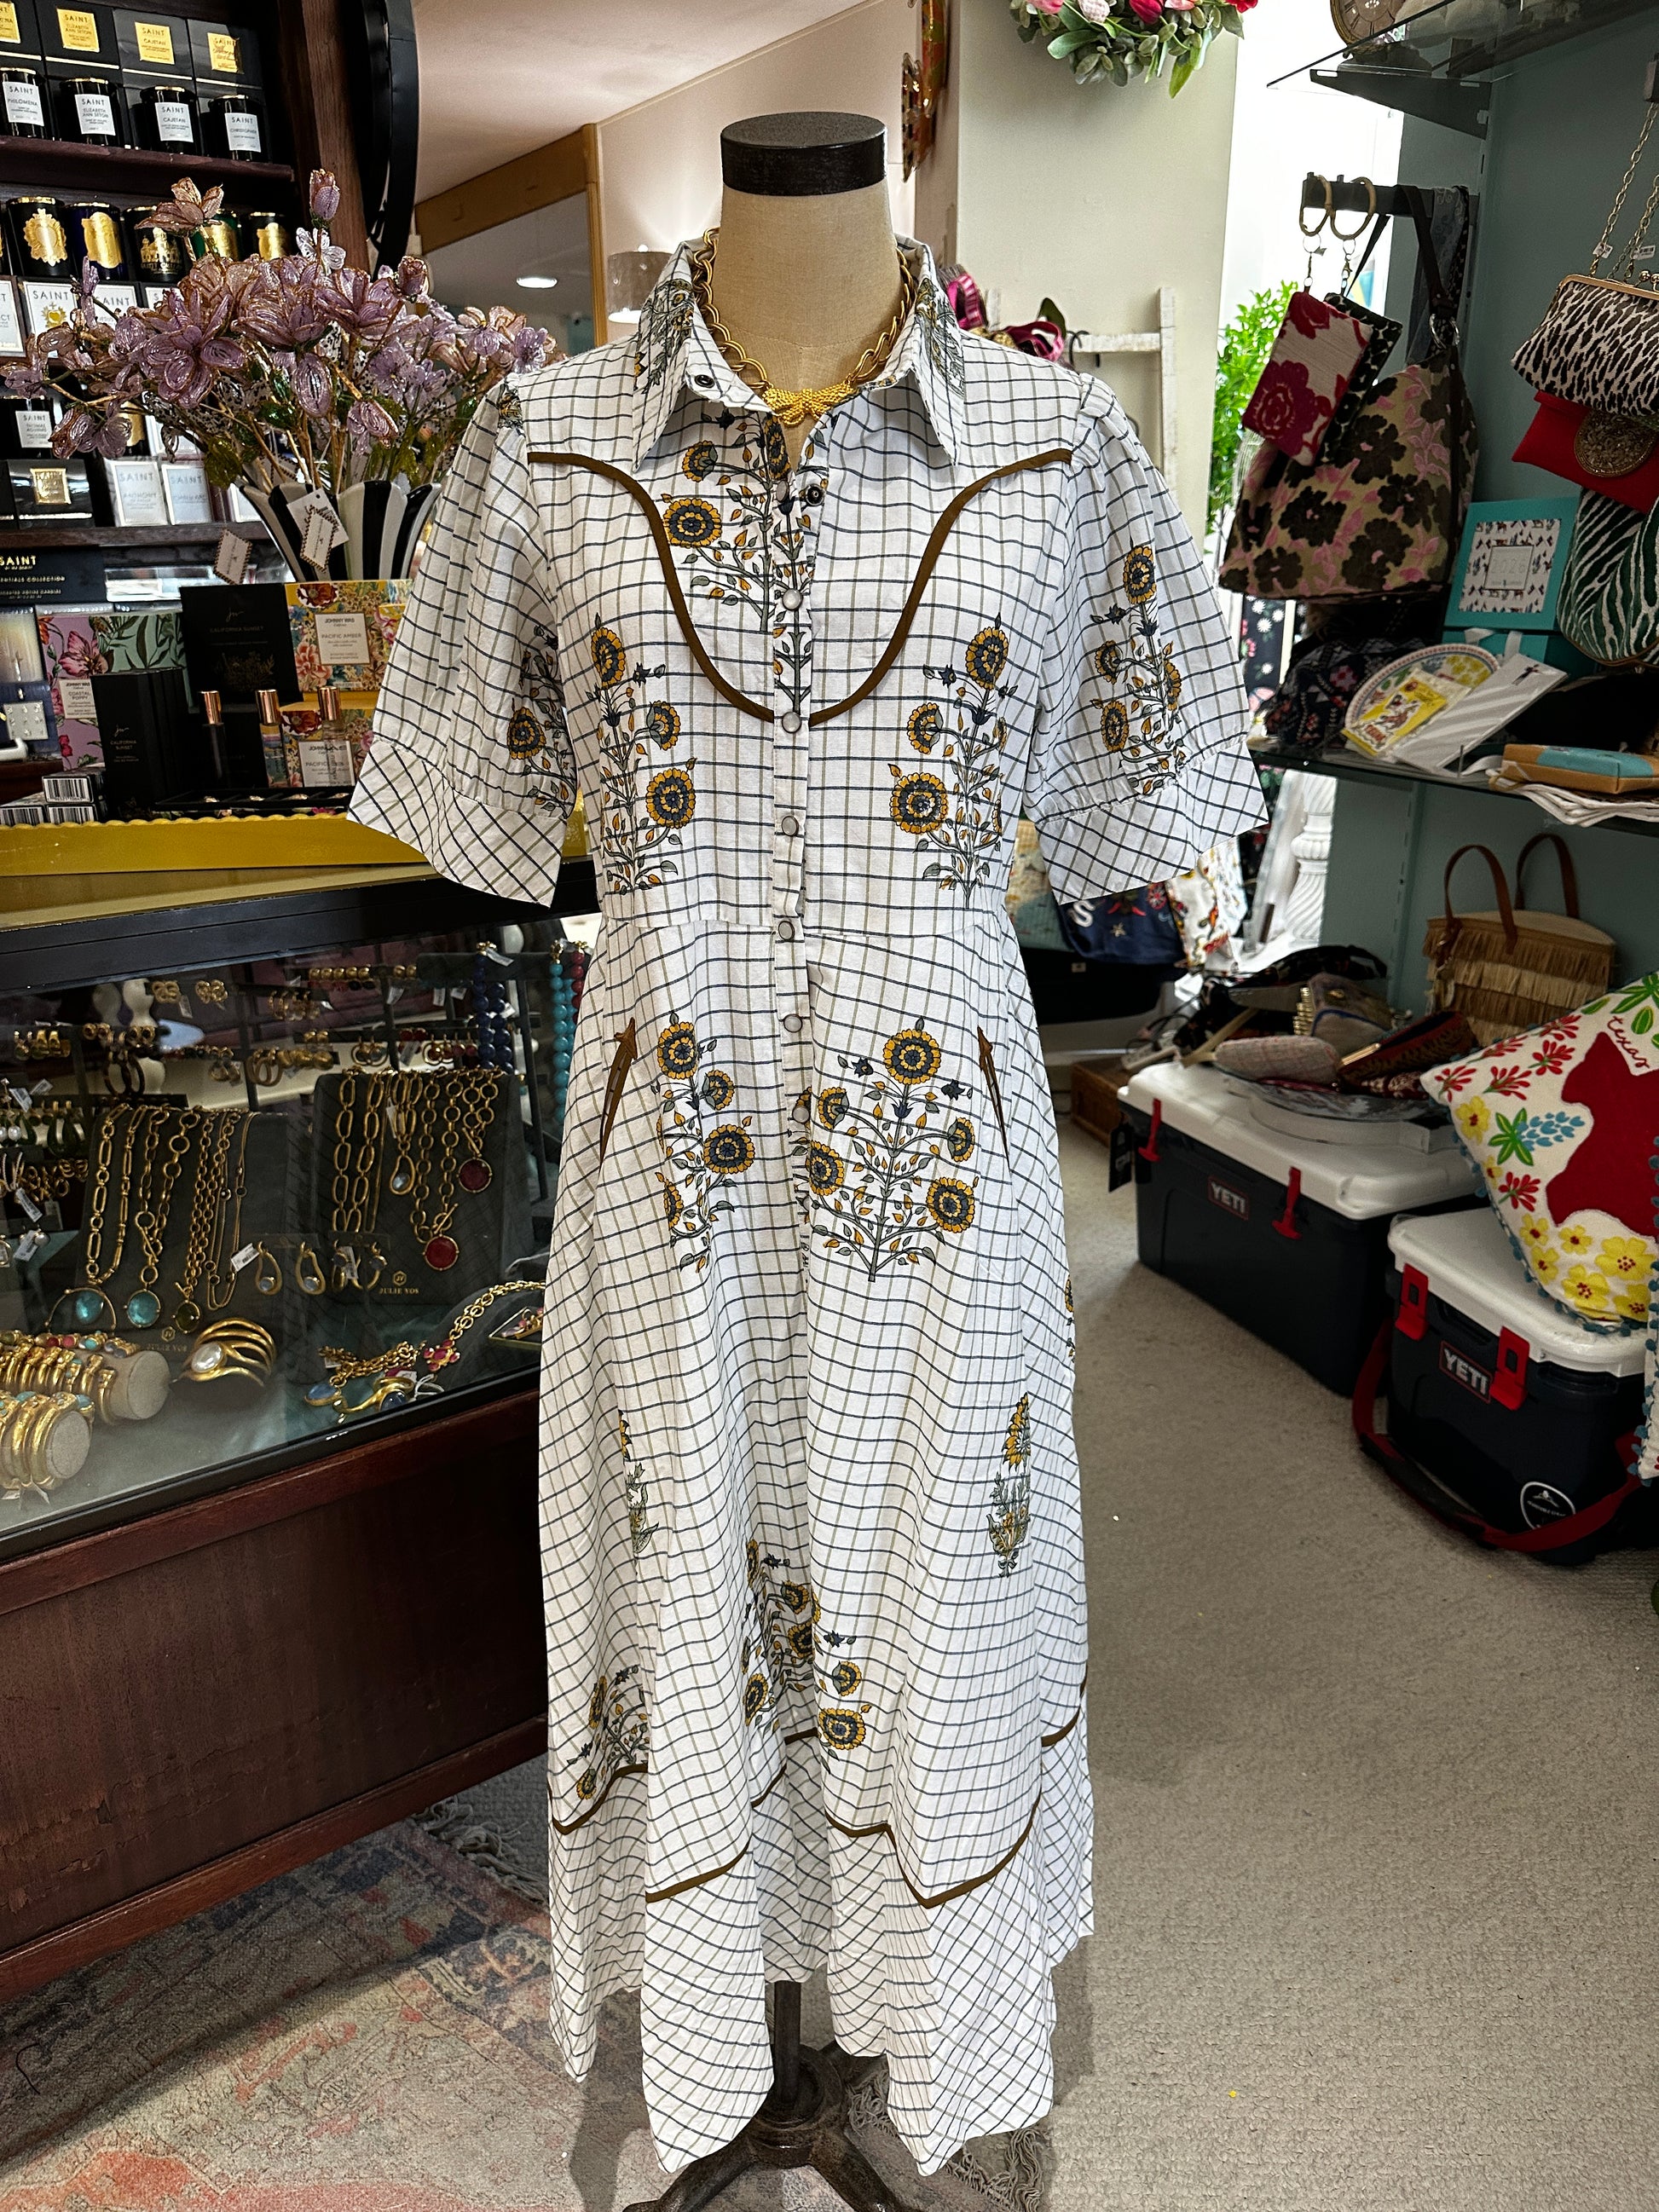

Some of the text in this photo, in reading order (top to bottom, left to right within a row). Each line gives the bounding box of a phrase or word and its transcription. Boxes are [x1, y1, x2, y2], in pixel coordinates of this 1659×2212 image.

[65, 14, 89, 23] SAINT
[142, 27, 165, 36] SAINT
[9, 86, 33, 95] SAINT
[231, 116, 253, 124] SAINT
[32, 290, 70, 301] SAINT
[95, 296, 130, 306] AINT
[119, 471, 153, 482] SAINT
[170, 475, 202, 484] SAINT
[0, 555, 37, 566] SAINT
[1607, 1015, 1650, 1069] texas
[1211, 1181, 1246, 1214] YETI
[1443, 1348, 1488, 1395] YETI
